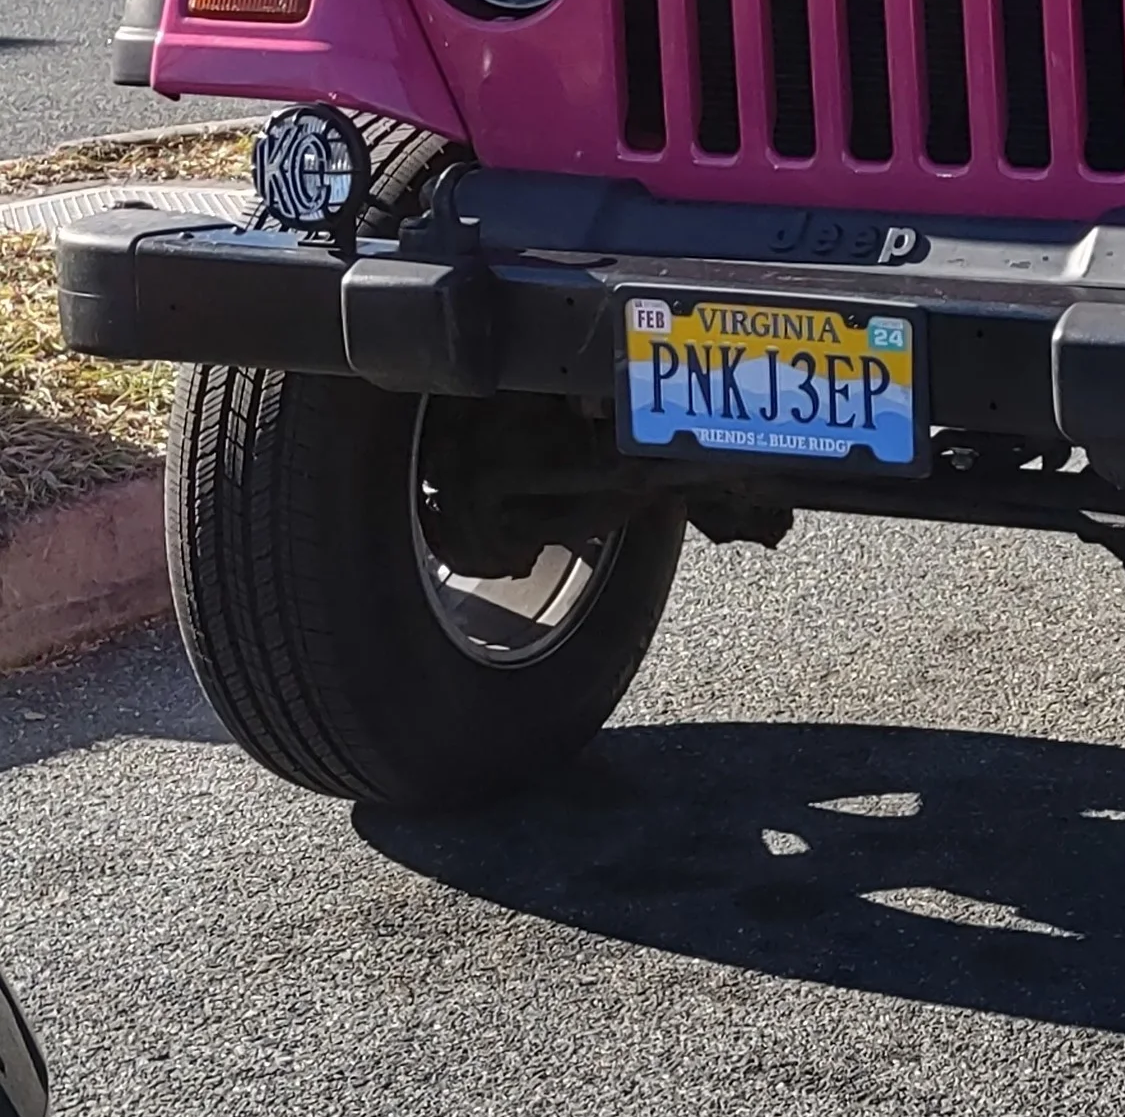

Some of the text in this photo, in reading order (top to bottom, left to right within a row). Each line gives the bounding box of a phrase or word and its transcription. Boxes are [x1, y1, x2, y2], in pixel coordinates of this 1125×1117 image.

[257, 125, 329, 219] KC
[767, 212, 918, 264] Jeep
[637, 309, 665, 329] FEB
[697, 307, 842, 344] VIRGINIA
[873, 328, 904, 348] 24
[650, 341, 890, 429] PNKJ3EP
[768, 433, 807, 449] BLUE
